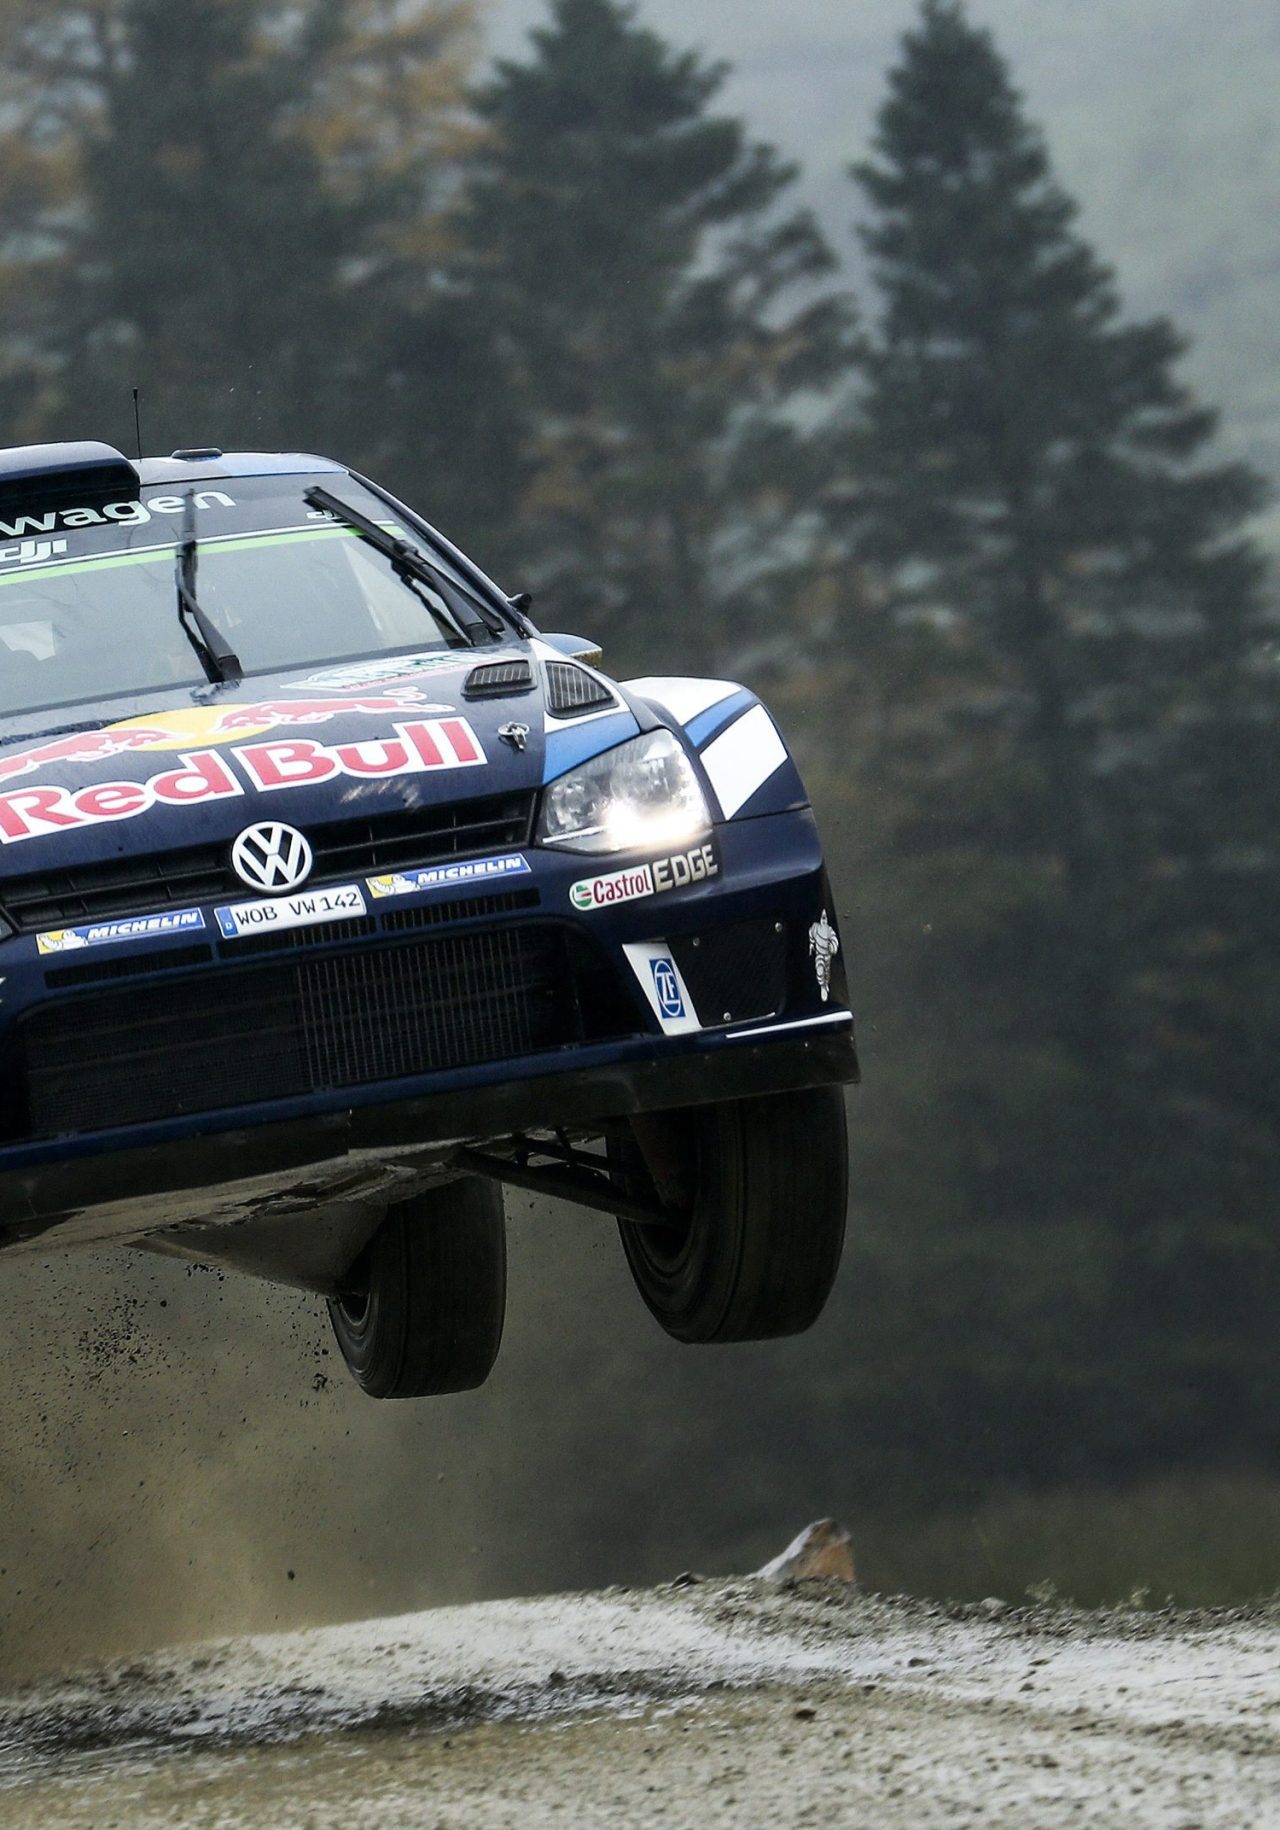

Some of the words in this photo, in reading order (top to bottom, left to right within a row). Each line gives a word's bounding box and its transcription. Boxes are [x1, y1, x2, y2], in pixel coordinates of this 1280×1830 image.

[247, 720, 479, 789] Bull
[232, 822, 313, 893] VW
[417, 857, 521, 883] MICHELIN
[592, 870, 651, 904] Castrol
[652, 845, 718, 892] EDGE
[236, 907, 278, 926] WOB
[291, 901, 317, 917] VW
[322, 891, 361, 912] 142
[88, 912, 199, 939] MICHELIN
[225, 922, 233, 930] D
[656, 973, 681, 1004] ZF
